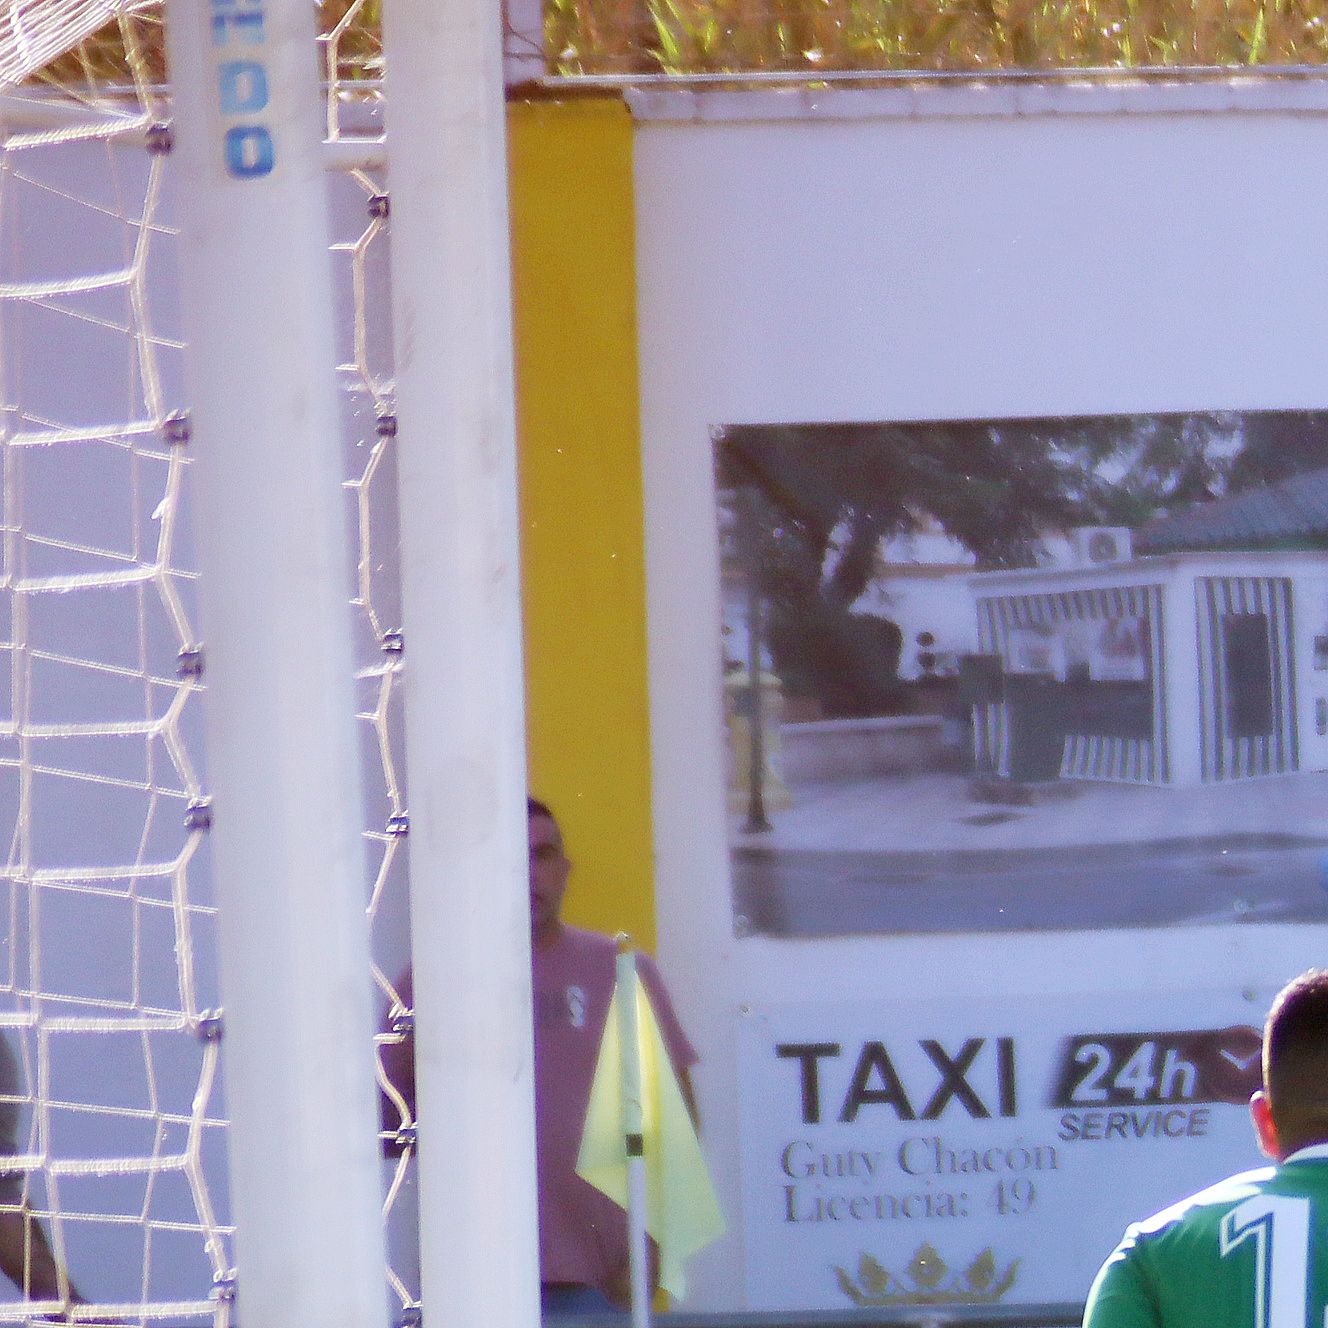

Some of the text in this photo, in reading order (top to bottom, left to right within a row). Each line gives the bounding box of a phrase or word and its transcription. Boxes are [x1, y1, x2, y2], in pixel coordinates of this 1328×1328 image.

[776, 1037, 1199, 1124] TAXI 24h
[1058, 1108, 1210, 1142] SERVICE
[781, 1136, 1059, 1180] Guty Chacón
[783, 1178, 1036, 1223] Licencia: 49
